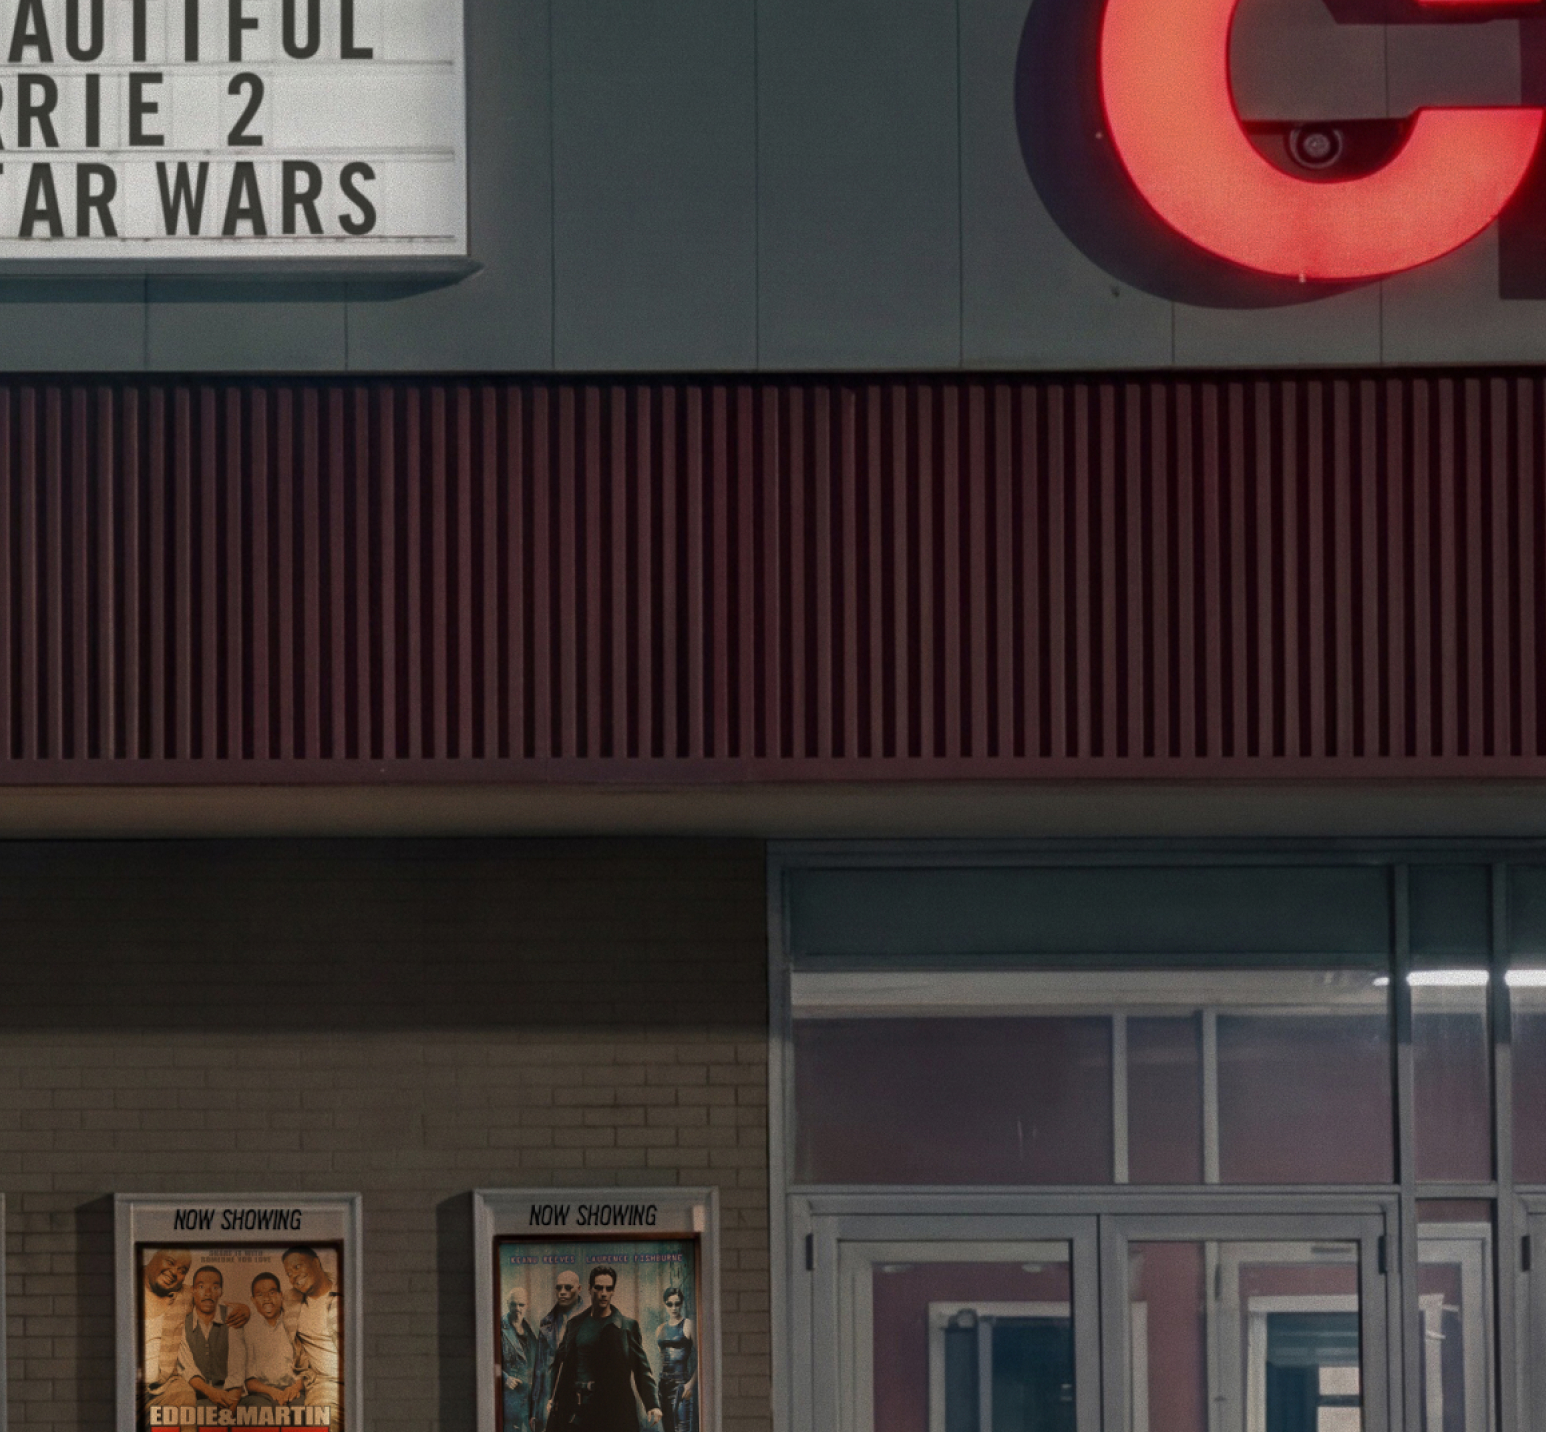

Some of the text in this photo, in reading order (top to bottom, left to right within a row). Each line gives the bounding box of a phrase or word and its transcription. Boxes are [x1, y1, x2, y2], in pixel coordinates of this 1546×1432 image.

[225, 72, 266, 148] 2
[154, 160, 379, 238] WARS
[173, 1208, 302, 1230] NOW SHOWING
[529, 1204, 657, 1226] NOW SHOWING
[542, 1255, 575, 1264] REEVES
[586, 1253, 683, 1264] LAURENCE FISHBURNE
[150, 1406, 330, 1426] EDDIE&MARTIN
